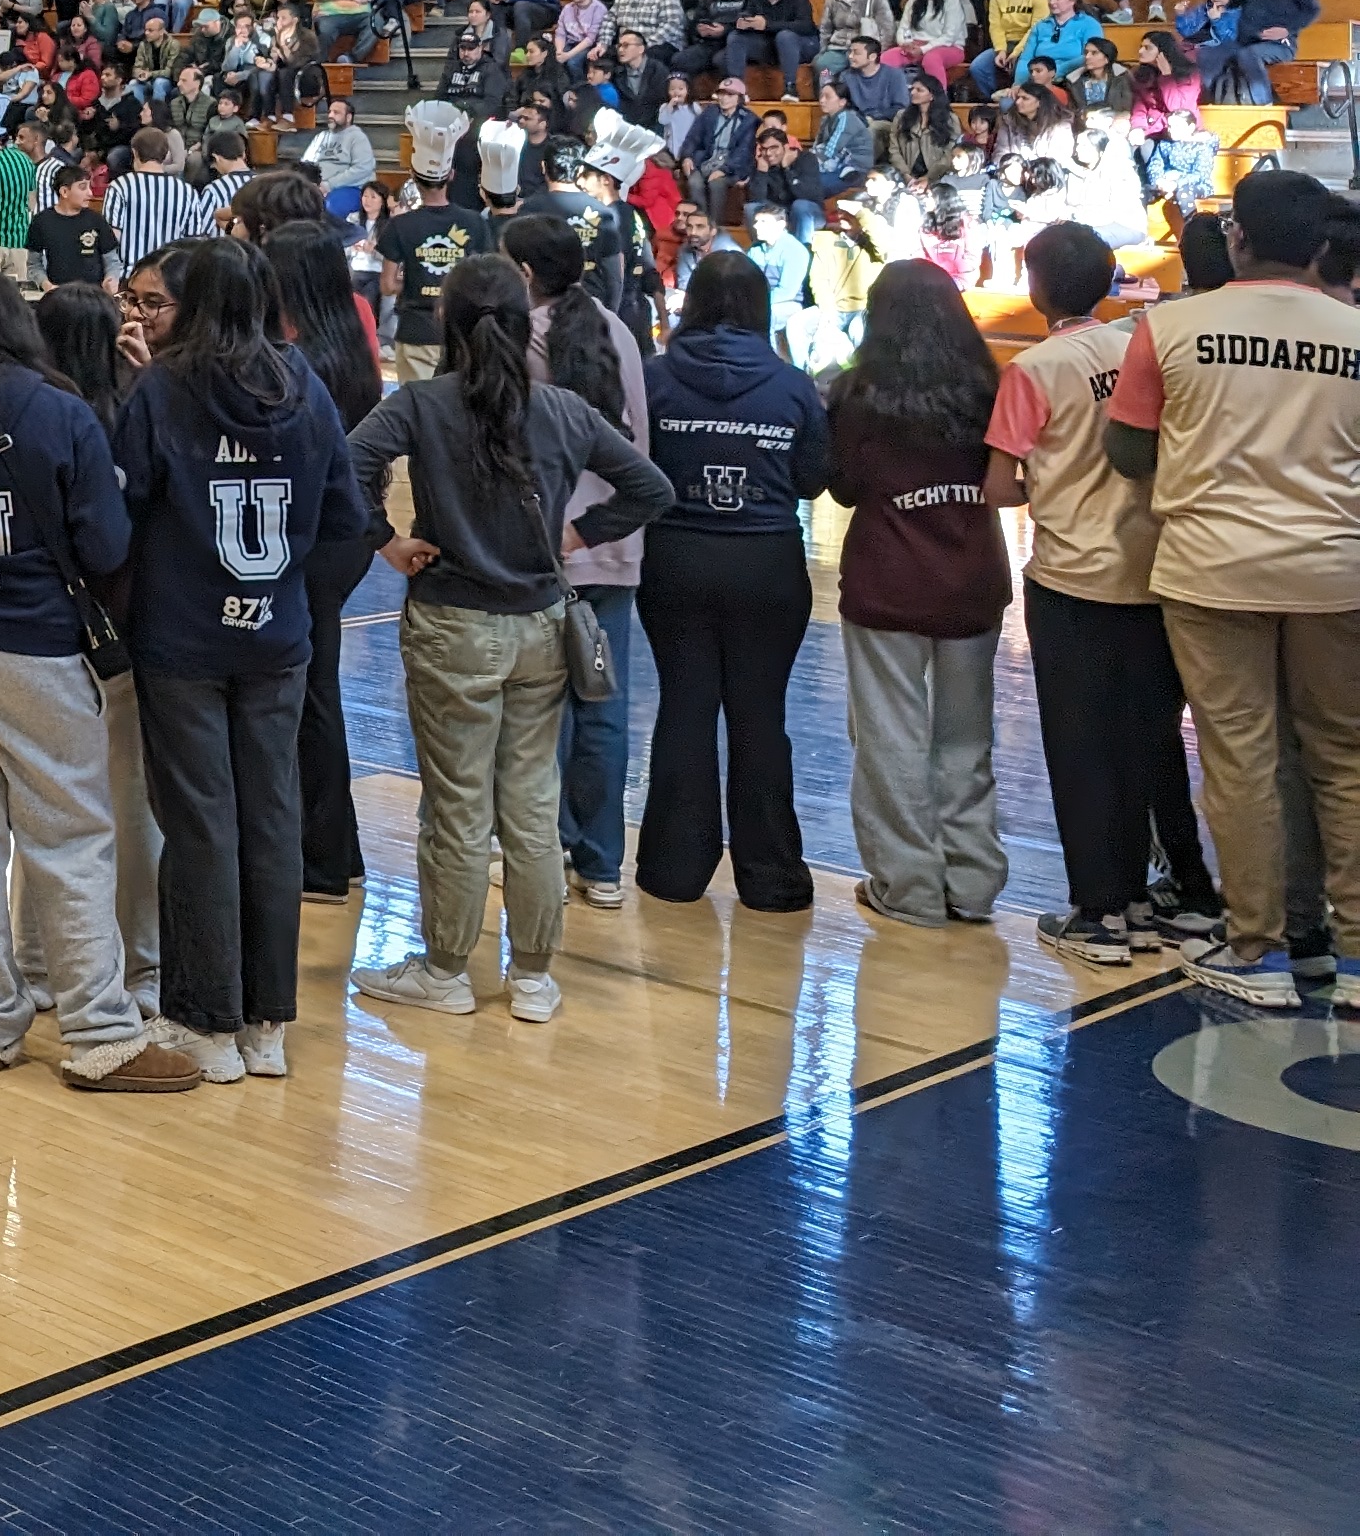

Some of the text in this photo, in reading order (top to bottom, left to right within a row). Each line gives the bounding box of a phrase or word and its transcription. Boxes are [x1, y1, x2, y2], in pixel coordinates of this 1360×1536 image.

[659, 418, 795, 440] CRYPTOHAWKS
[704, 465, 747, 512] U
[209, 478, 292, 581] U
